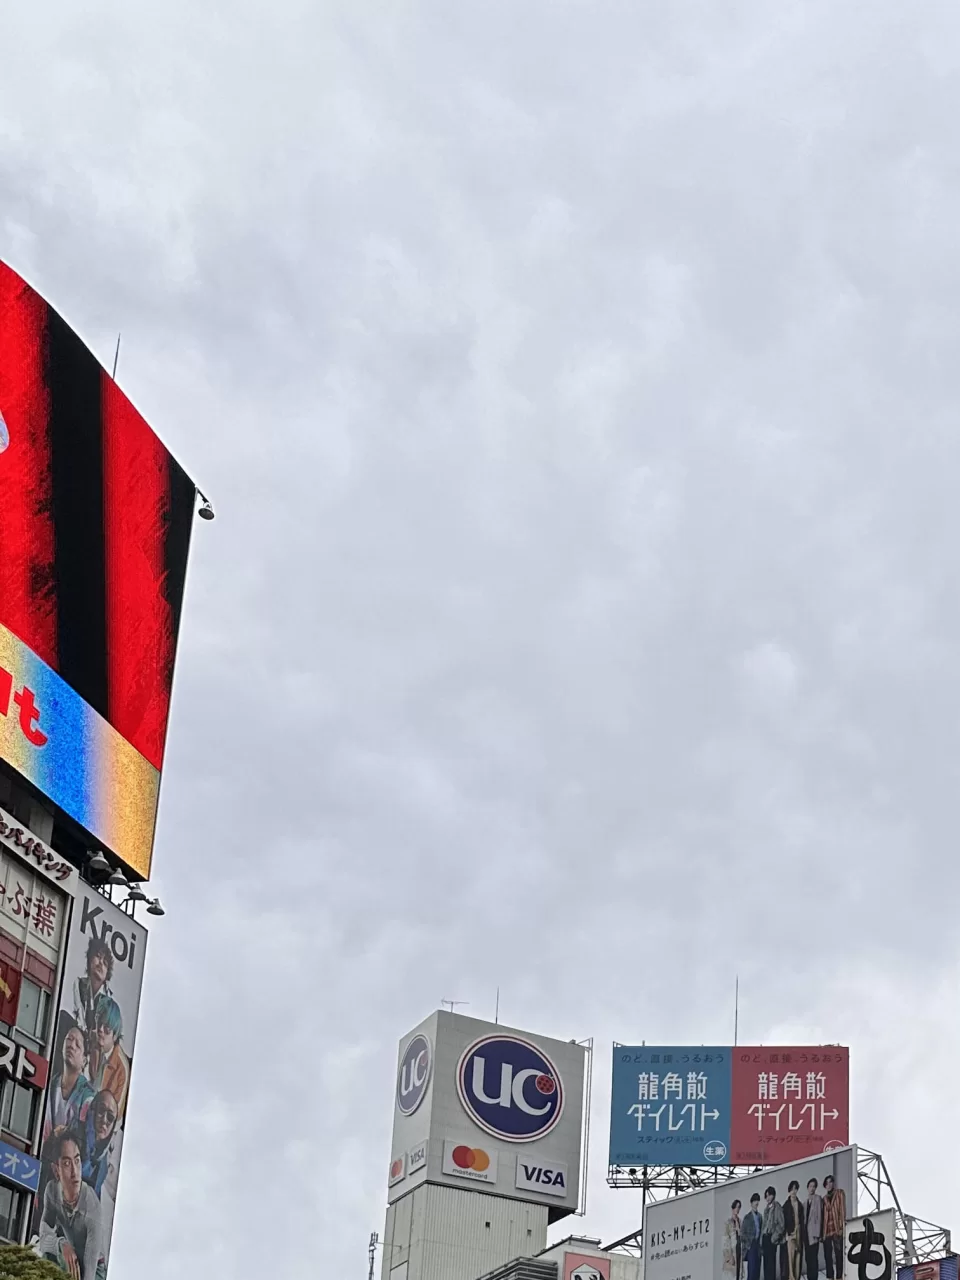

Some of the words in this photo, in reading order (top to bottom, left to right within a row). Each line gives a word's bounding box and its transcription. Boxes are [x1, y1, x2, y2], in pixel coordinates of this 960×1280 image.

[0, 814, 74, 881] バイキング
[79, 896, 137, 969] Kroi
[401, 1050, 428, 1096] UC
[472, 1055, 552, 1117] UC
[638, 1071, 708, 1100] 龍角散
[758, 1071, 827, 1100] 龍角散
[627, 1103, 720, 1131] ダイレクト
[747, 1103, 839, 1131] ダイレクト
[0, 1148, 36, 1179] オン
[452, 1168, 488, 1180] mastercard
[520, 1163, 566, 1188] VISA
[650, 1218, 711, 1248] KIS-MY-FT2
